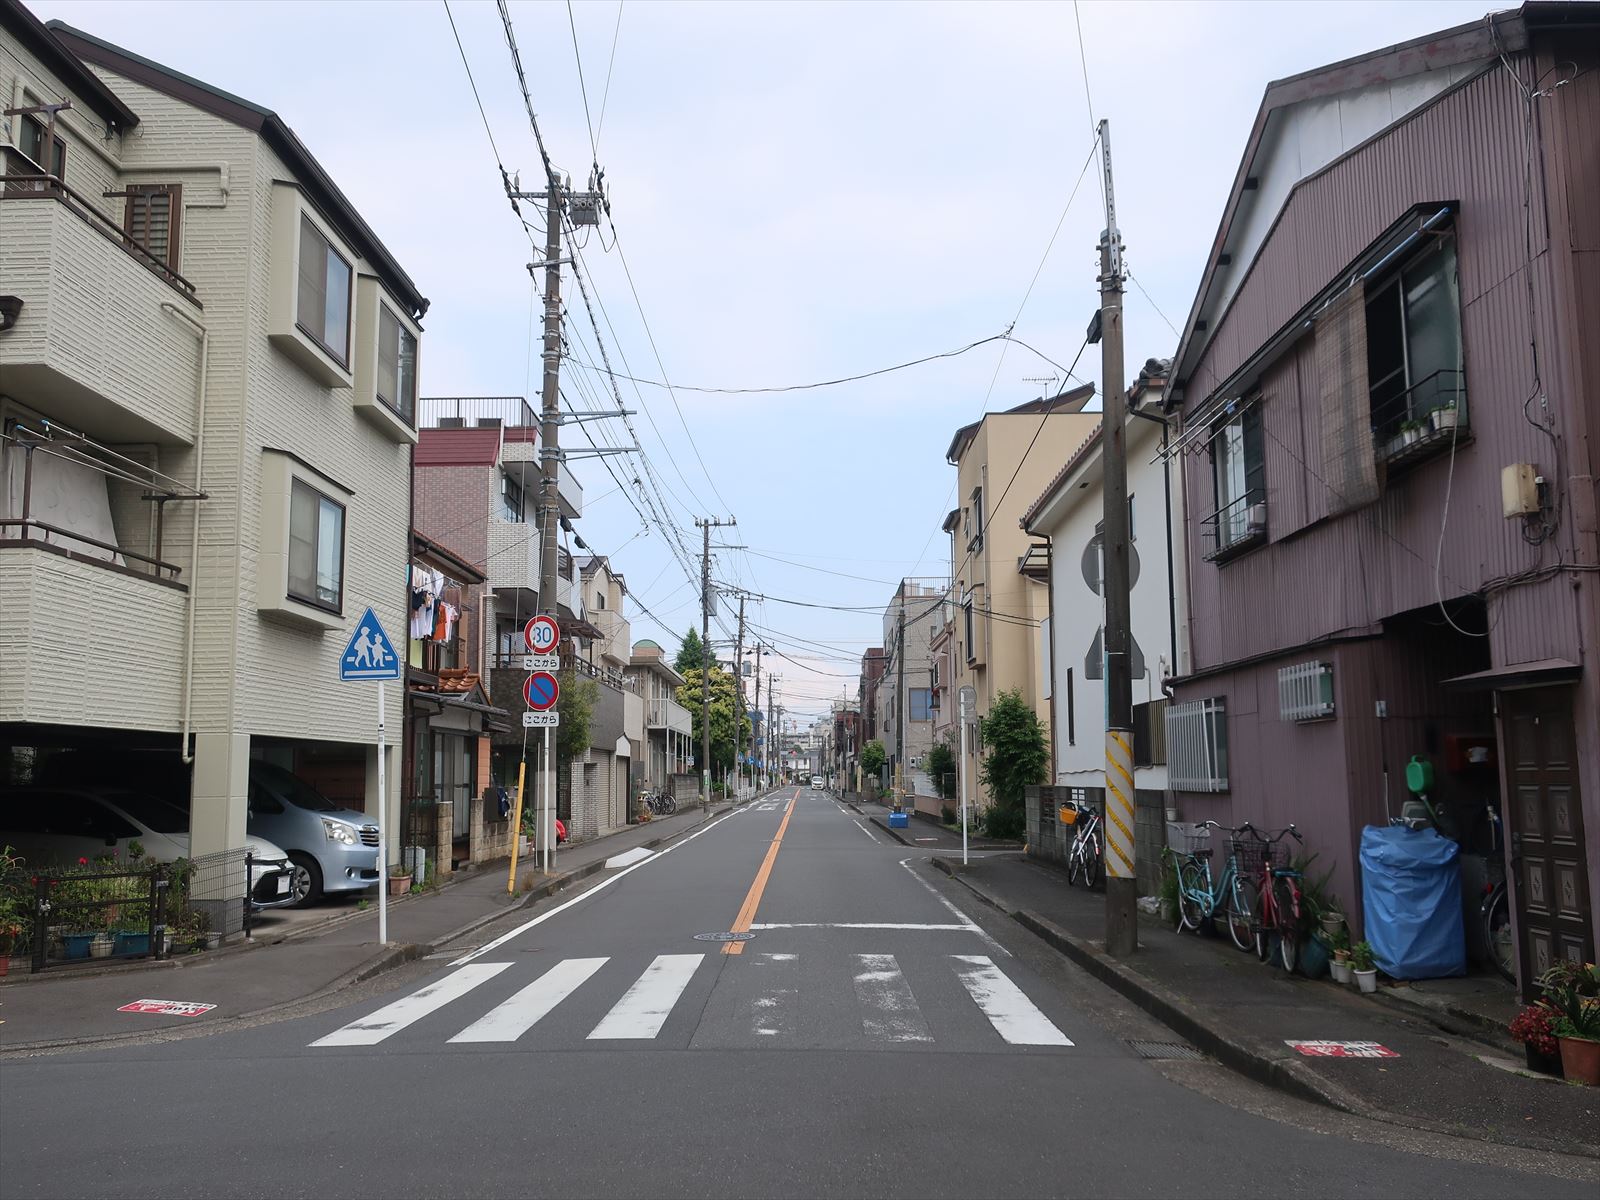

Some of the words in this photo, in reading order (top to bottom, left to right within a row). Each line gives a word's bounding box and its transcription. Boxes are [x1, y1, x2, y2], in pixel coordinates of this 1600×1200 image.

[533, 626, 552, 643] 30
[525, 659, 557, 667] ここから
[525, 715, 557, 724] ここから
